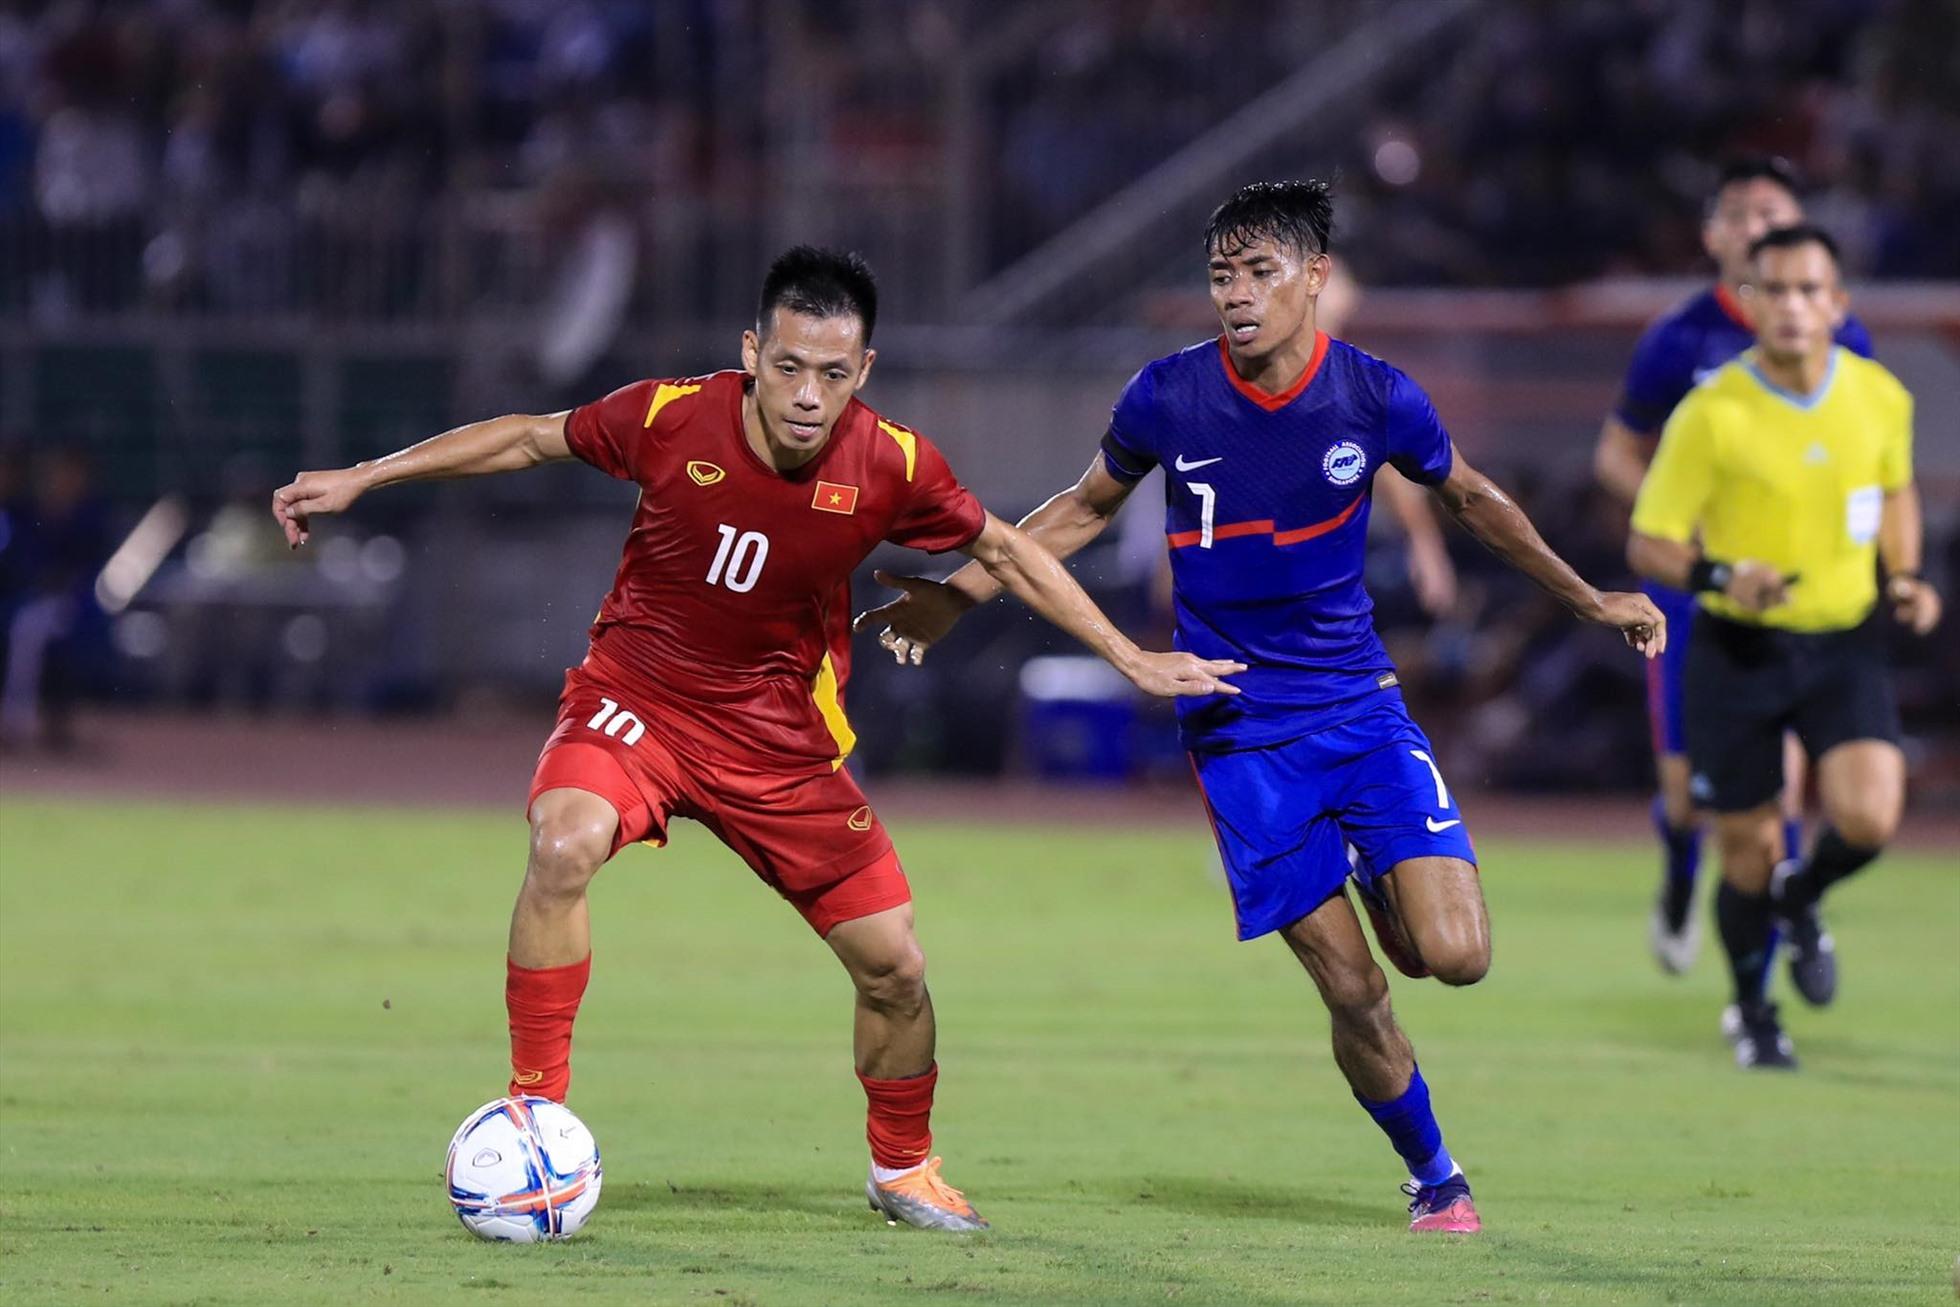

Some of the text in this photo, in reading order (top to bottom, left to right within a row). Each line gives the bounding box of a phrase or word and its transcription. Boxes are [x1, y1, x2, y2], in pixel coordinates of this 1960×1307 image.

[1186, 482, 1216, 549] 7
[705, 523, 770, 593] 10
[586, 697, 646, 747] 10
[1409, 749, 1450, 810] 7
